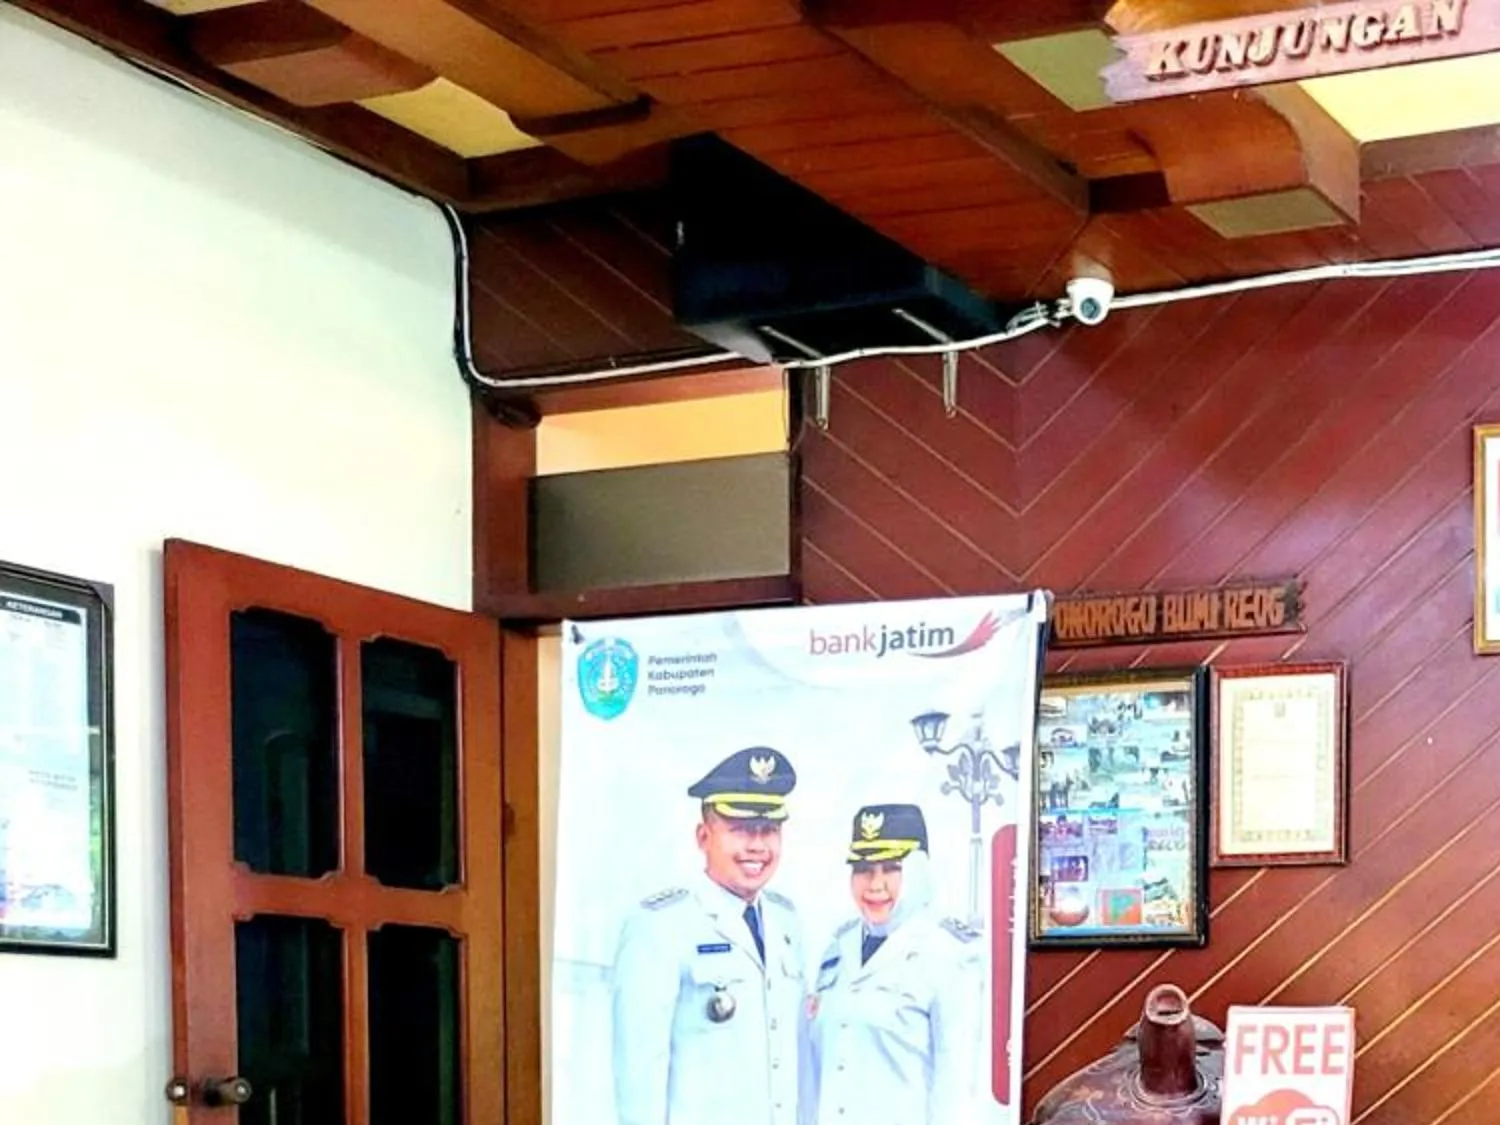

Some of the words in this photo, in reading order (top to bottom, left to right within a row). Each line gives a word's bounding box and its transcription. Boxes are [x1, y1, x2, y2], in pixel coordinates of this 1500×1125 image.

[1145, 0, 1466, 79] KUNJUNGAN
[1054, 594, 1157, 638] ONOROGO
[1162, 588, 1220, 633] BUMI
[809, 622, 955, 658] bankjatim
[647, 652, 718, 665] Pemerintah
[647, 668, 715, 681] Kabupaten
[647, 683, 706, 696] Ponorogo
[1233, 1023, 1346, 1077] FREE
